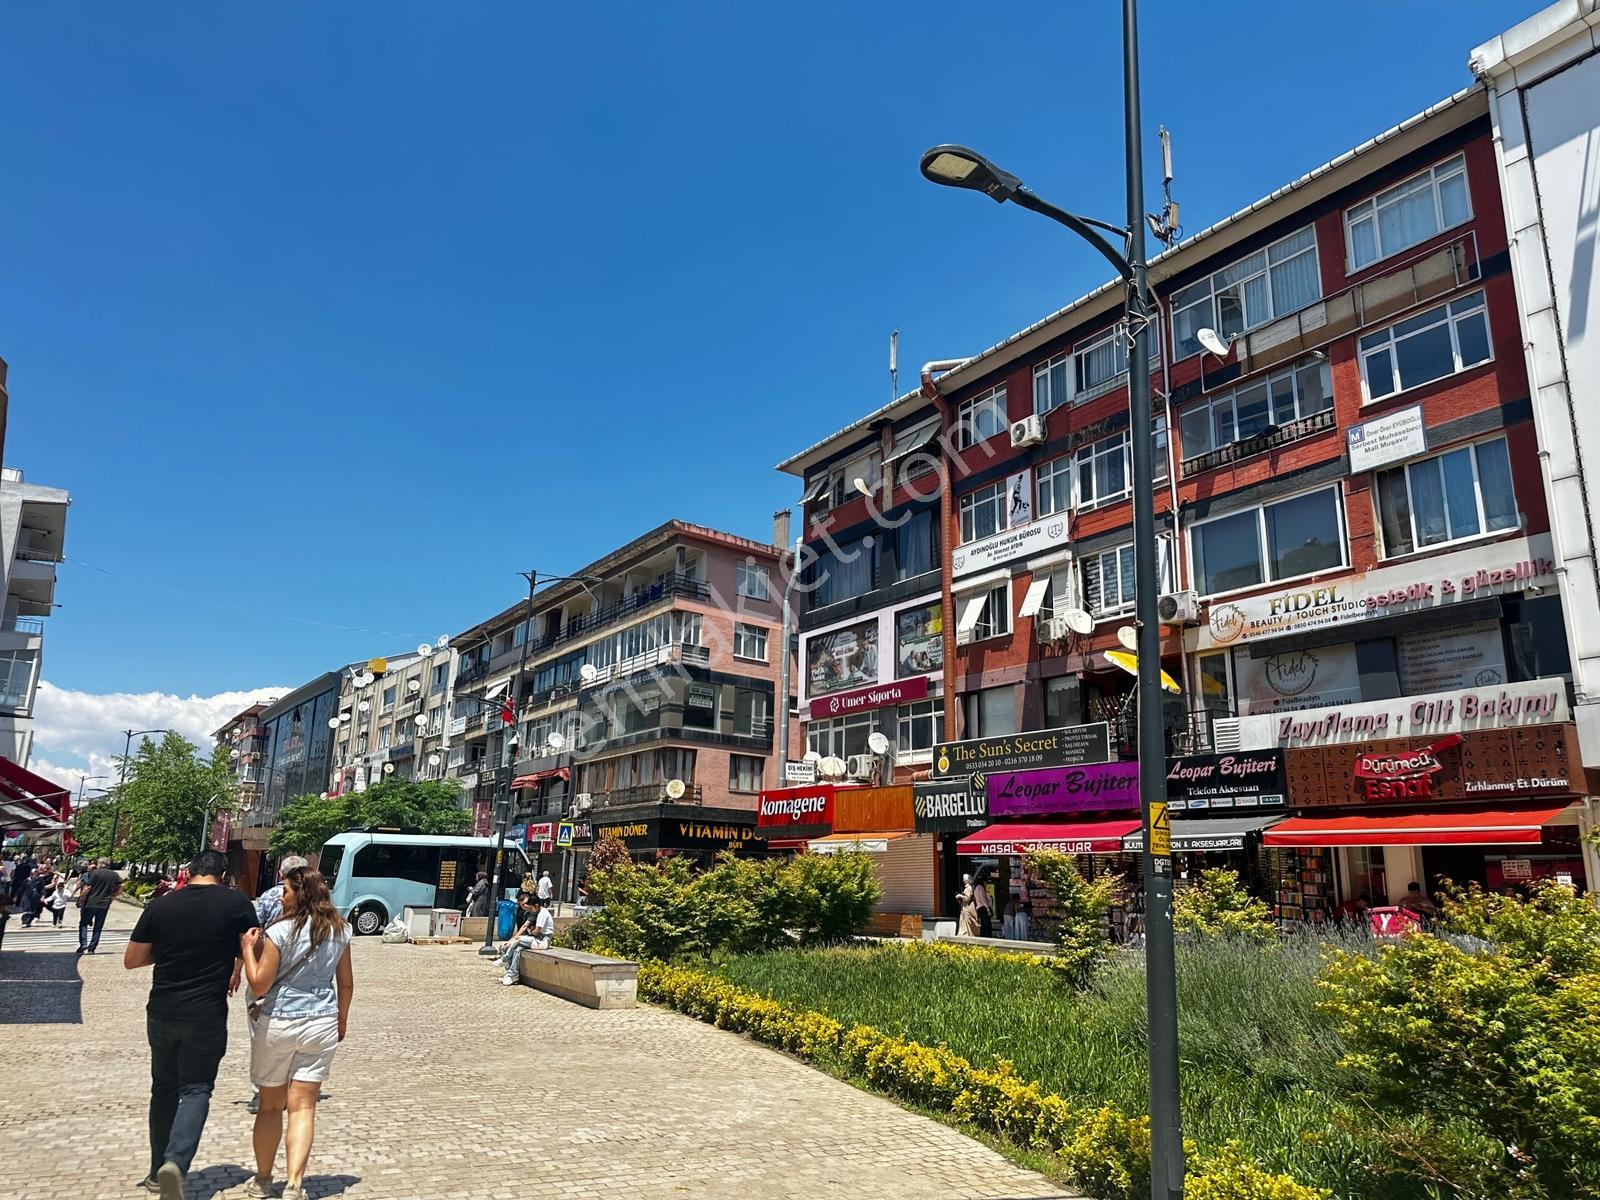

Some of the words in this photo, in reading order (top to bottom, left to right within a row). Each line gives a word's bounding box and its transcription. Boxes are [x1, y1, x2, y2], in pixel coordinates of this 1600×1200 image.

[1351, 438, 1378, 450] Serbest
[1364, 445, 1379, 454] Mali
[970, 539, 998, 556] AYDINOĞLU
[1000, 534, 1018, 548] HUKUK
[1018, 526, 1042, 540] BÜROSU
[1366, 582, 1434, 608] estetik
[1440, 578, 1456, 594] &
[1461, 558, 1554, 594] güzellik
[1269, 585, 1344, 616] FİDEL
[1250, 616, 1283, 629] BEAUTY
[1296, 606, 1329, 620] TOUCH
[1332, 600, 1366, 613] STUDIO
[868, 688, 902, 704] Sigorta
[1278, 710, 1388, 741] Zayıflama
[1410, 699, 1454, 726] Cilt
[1460, 691, 1557, 720] Bakımı
[953, 745, 976, 761] The
[978, 739, 1012, 758] Sun's
[1014, 736, 1058, 754] Secret
[966, 761, 978, 770] 0533
[978, 761, 987, 769] 034
[988, 760, 994, 768] 20
[1018, 756, 1028, 764] 370
[1036, 754, 1043, 762] 09
[1166, 760, 1215, 781] Leopar
[1219, 756, 1277, 778] Bujiteri
[1362, 752, 1432, 772] Dürümcü
[998, 776, 1060, 800] Leopar
[1187, 786, 1217, 796] Telefon
[1364, 772, 1432, 800] Esnaf
[1465, 779, 1514, 793] Zırhlanmış
[1518, 778, 1529, 789] Et
[1532, 776, 1568, 788] Dürüm
[760, 795, 826, 820] komagene
[624, 822, 648, 837] DÖNER
[679, 822, 738, 840] VİTAMİN
[981, 844, 1018, 853] MASAL
